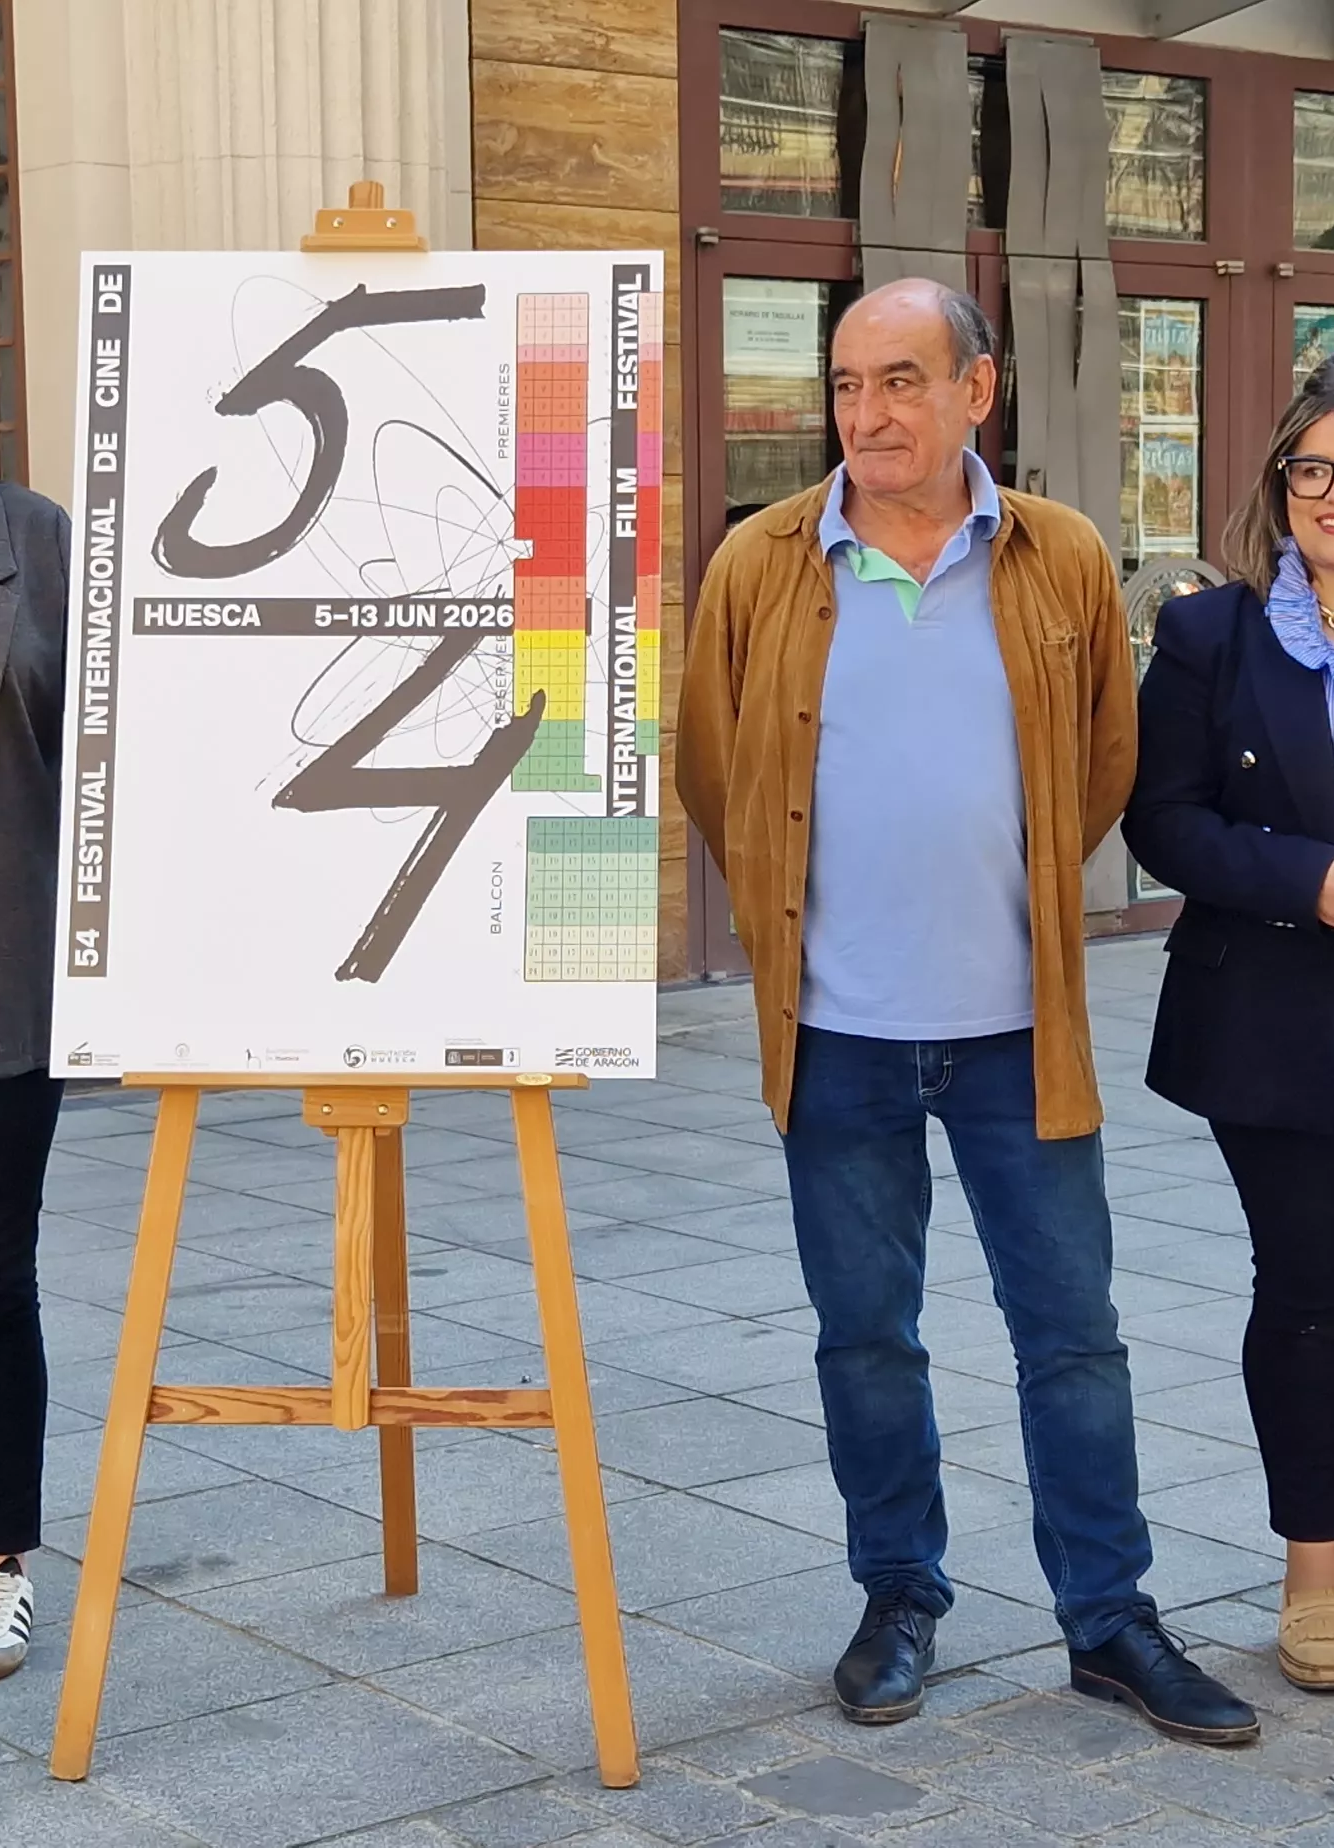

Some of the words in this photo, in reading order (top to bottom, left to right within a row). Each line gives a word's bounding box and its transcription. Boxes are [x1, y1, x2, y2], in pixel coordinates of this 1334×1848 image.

[99, 274, 124, 313] DE
[95, 339, 121, 408] CINE
[617, 273, 642, 410] FESTIVAL
[93, 432, 117, 473] DE
[152, 283, 486, 580] 5
[616, 468, 637, 538] FILM
[83, 499, 116, 734] INTERNACIONAL
[144, 604, 261, 627] HUESCA
[383, 604, 437, 628] JUN
[443, 604, 514, 628] 2026
[613, 596, 638, 816] NTERNATIONAL
[271, 585, 545, 984] 4
[77, 762, 107, 902] FESTIVAL
[490, 861, 503, 934] BALCON
[74, 928, 100, 967] 54
[575, 1047, 631, 1057] GOBIERNO
[575, 1058, 589, 1067] DE
